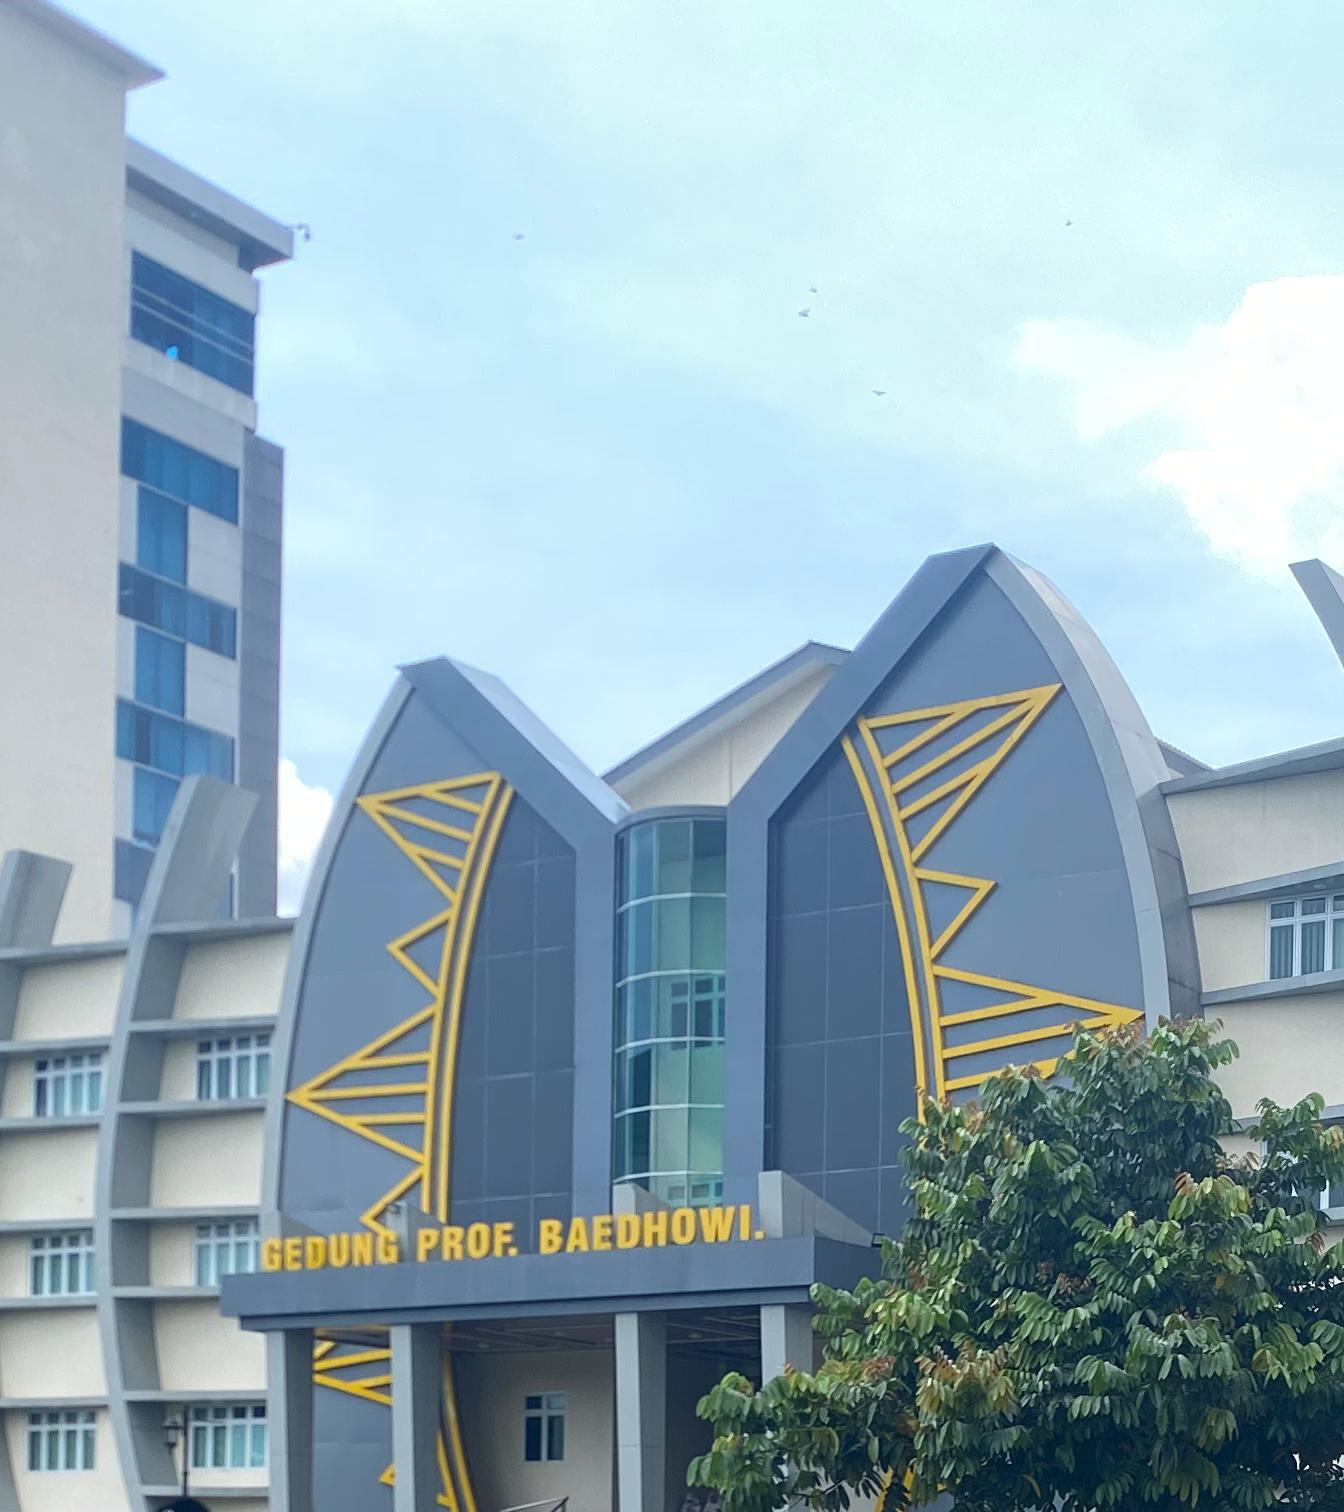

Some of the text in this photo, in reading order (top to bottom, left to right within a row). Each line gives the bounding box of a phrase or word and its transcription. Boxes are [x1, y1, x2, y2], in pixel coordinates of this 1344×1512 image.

[261, 1204, 766, 1272] GEDUNG PROF. BAEDHOWI.
